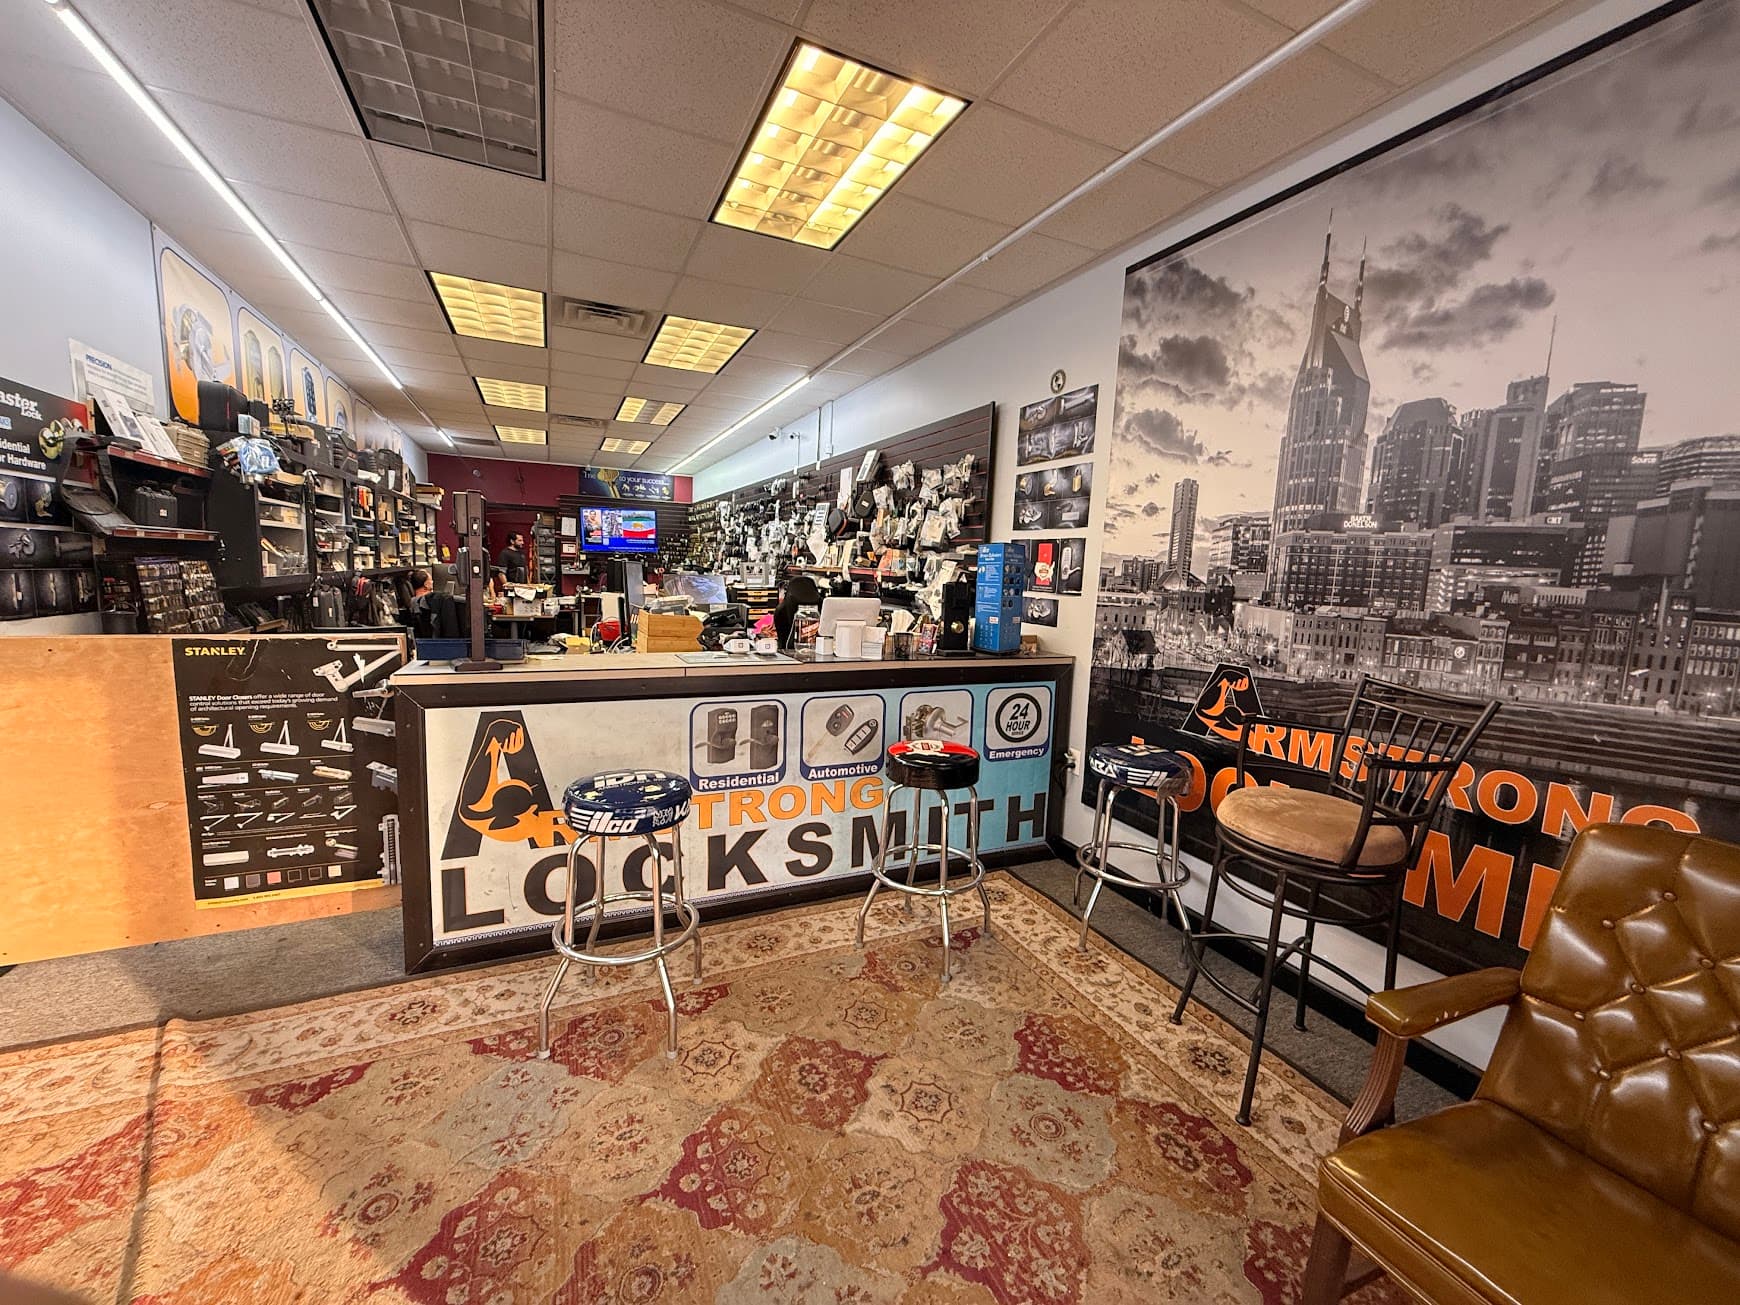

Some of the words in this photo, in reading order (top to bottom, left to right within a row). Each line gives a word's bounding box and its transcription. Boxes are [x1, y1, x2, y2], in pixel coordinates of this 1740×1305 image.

[21, 408, 43, 420] Lock
[7, 454, 46, 470] Hardware
[185, 646, 246, 656] STANLEY
[1009, 703, 1030, 721] 24
[1005, 720, 1031, 732] HOUR
[989, 747, 1045, 760] Emergency
[807, 762, 879, 780] Automotive
[698, 772, 780, 791] Residential
[587, 811, 640, 834] ilco
